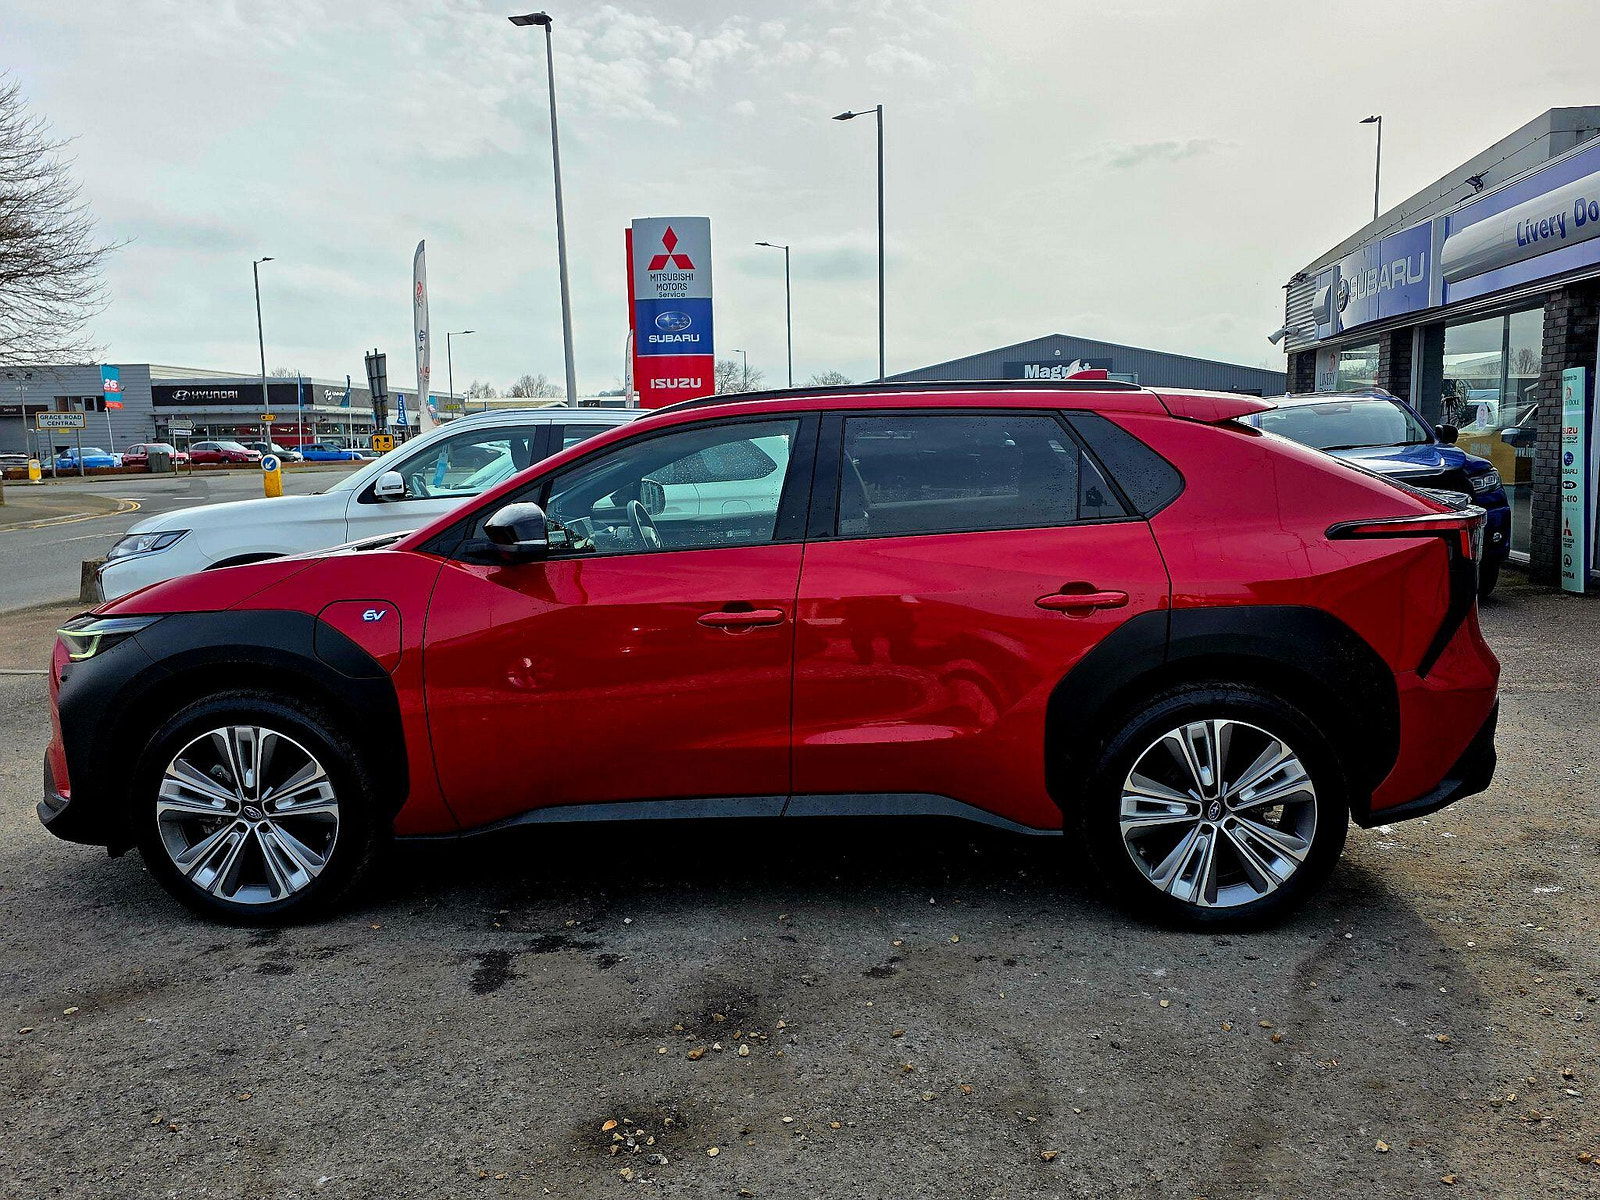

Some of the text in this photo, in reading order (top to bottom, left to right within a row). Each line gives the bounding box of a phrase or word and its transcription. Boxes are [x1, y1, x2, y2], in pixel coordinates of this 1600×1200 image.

[1516, 211, 1567, 247] Livery
[650, 273, 694, 282] MITSUBISHI
[1349, 251, 1425, 303] SUBARU
[656, 282, 688, 291] MOTORS
[648, 334, 700, 342] SUBARU
[1025, 363, 1091, 379] Magnt
[104, 379, 117, 389] 26
[651, 379, 701, 388] ISUZU
[192, 390, 238, 399] HYUNDAI
[362, 609, 388, 621] EV
